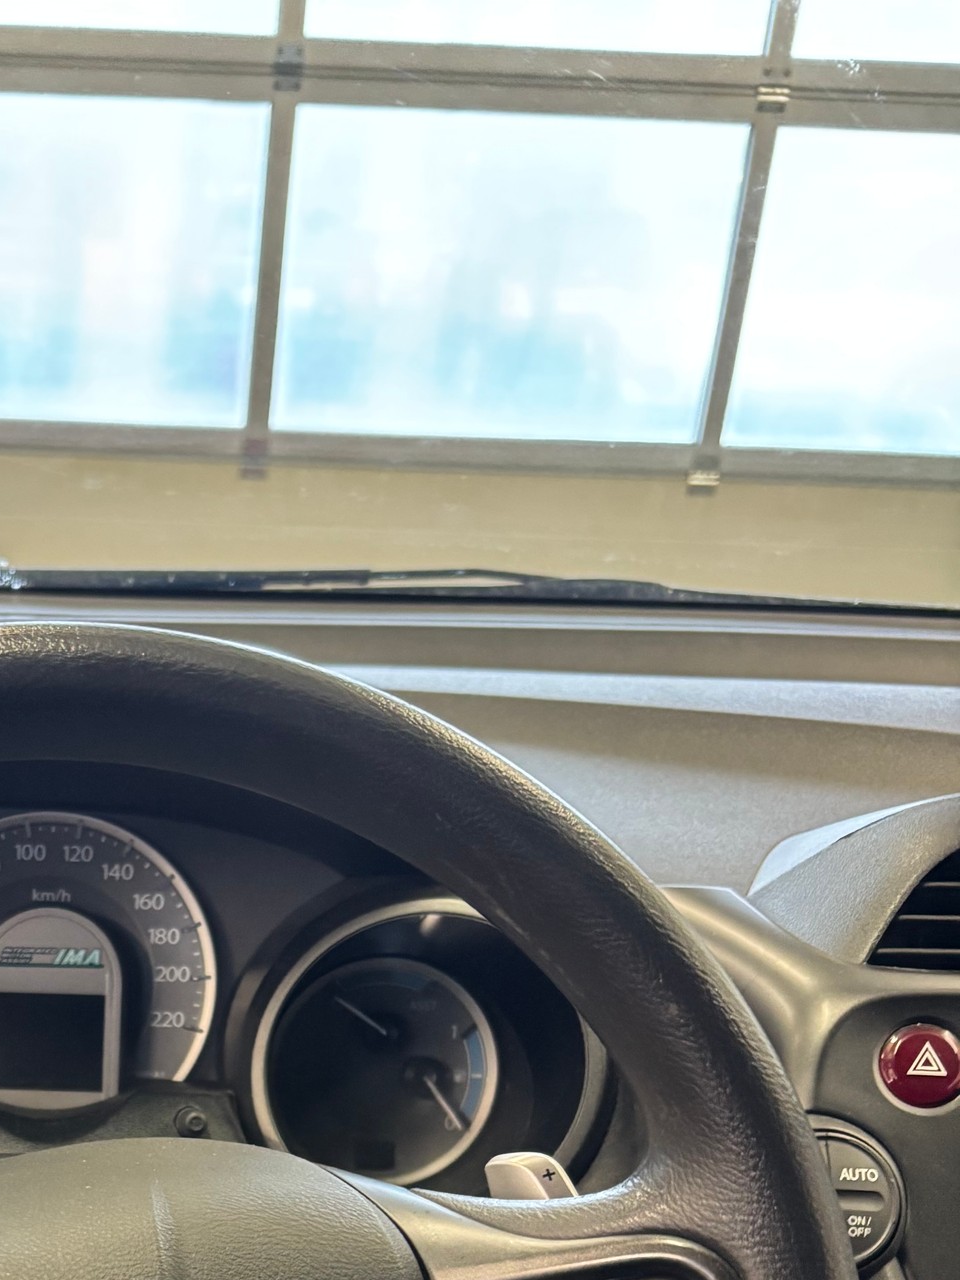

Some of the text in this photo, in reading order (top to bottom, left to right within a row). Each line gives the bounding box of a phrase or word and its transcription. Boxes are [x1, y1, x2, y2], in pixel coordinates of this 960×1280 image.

[16, 844, 46, 862] 100
[63, 845, 94, 863] 120
[102, 863, 134, 881] 140
[32, 889, 71, 902] km/h
[133, 893, 165, 911] 160
[148, 928, 180, 945] 180
[53, 948, 101, 965] IMA
[155, 966, 190, 983] 200
[152, 1011, 184, 1029] 220
[839, 1167, 878, 1182] AUTO
[847, 1215, 872, 1227] ON/
[847, 1226, 872, 1238] OFF
